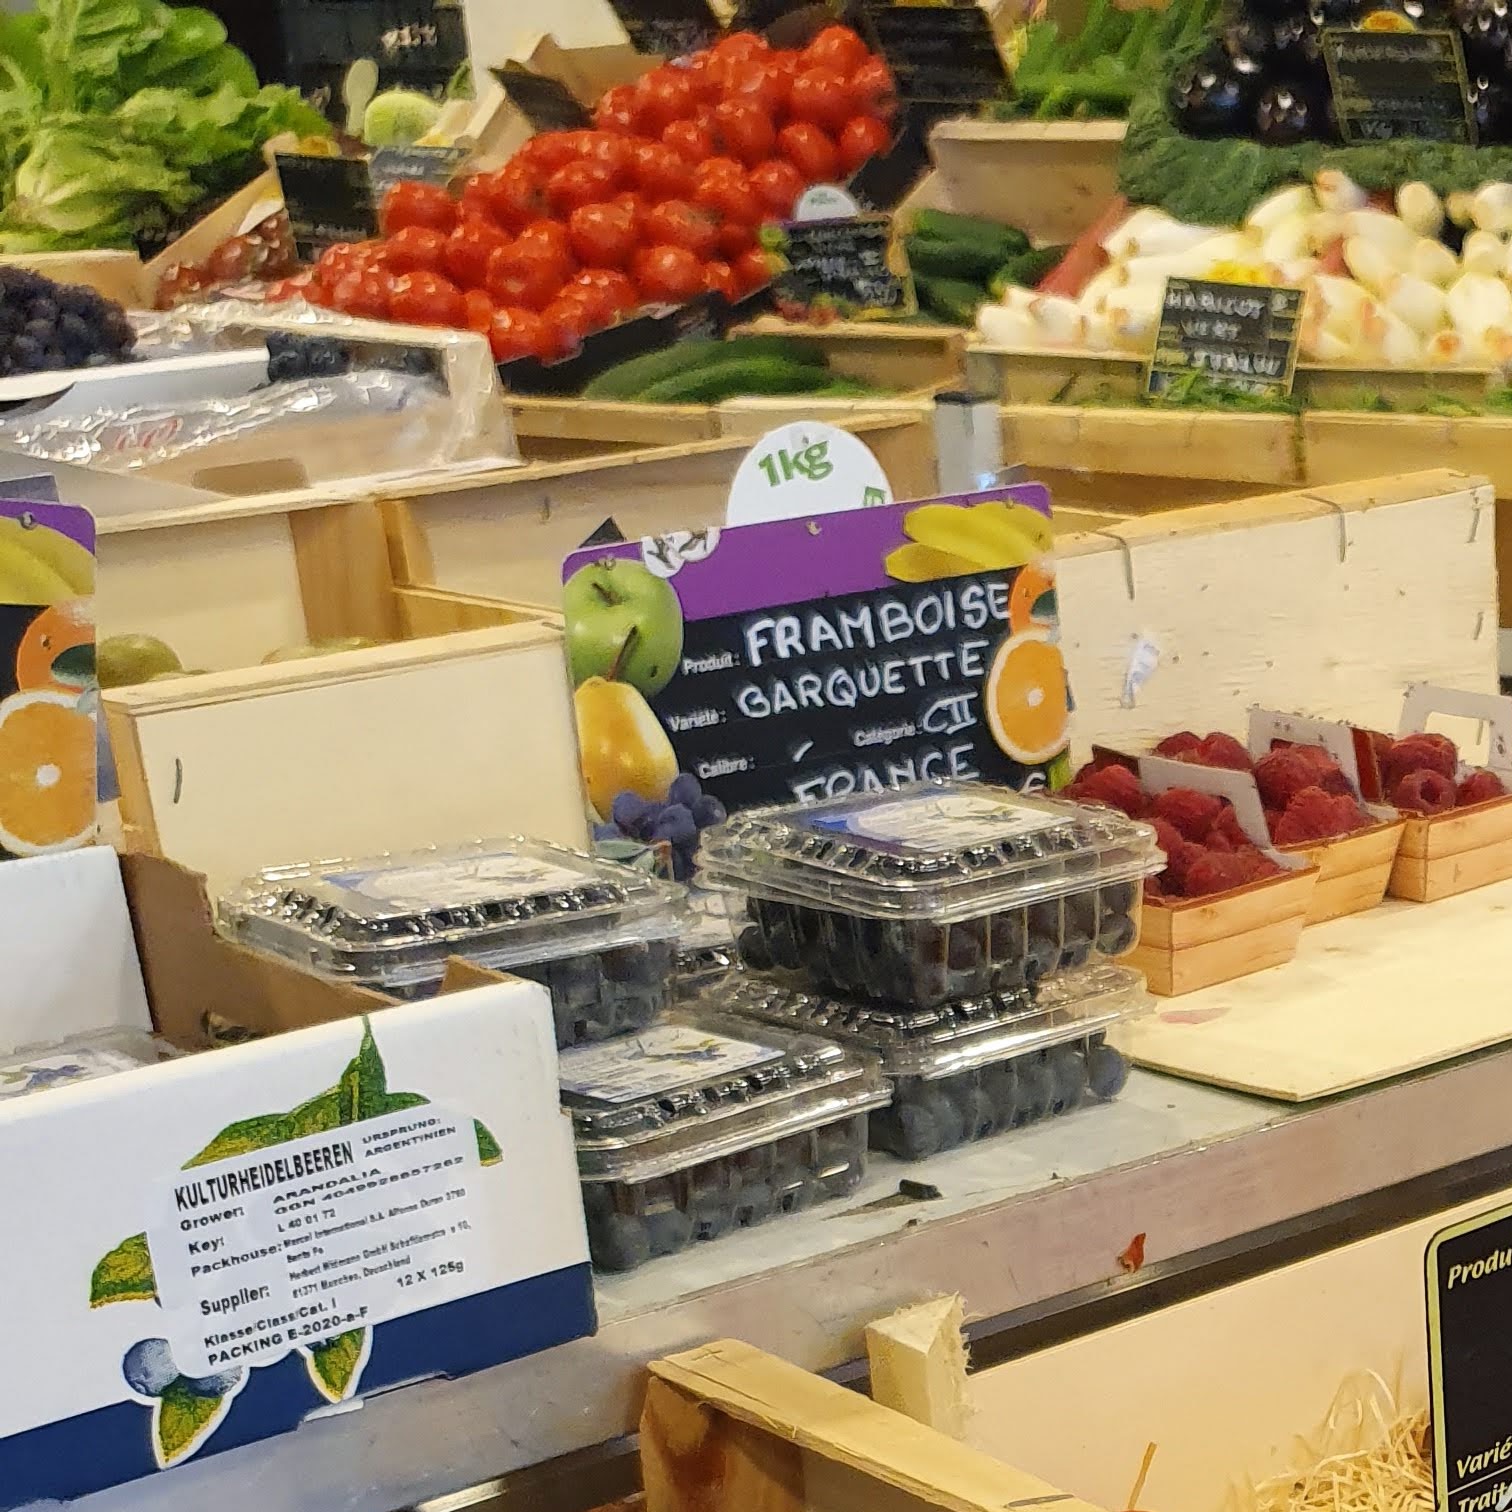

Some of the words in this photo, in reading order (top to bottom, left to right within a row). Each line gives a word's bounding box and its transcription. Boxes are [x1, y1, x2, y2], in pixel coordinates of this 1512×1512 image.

[758, 440, 834, 487] 1kg
[745, 582, 1011, 668] FRAMBOISE
[793, 743, 981, 803] FRANCE
[174, 1140, 355, 1212] KULTURHEIDELBEEREN
[180, 1206, 245, 1232] Grower:
[188, 1236, 225, 1256] Key:
[190, 1243, 283, 1278] Packhouse:
[396, 1273, 414, 1289] 12
[416, 1269, 428, 1283] X
[430, 1260, 465, 1278] 125g
[200, 1284, 271, 1316] Supplier:
[207, 1333, 284, 1367] PACKING
